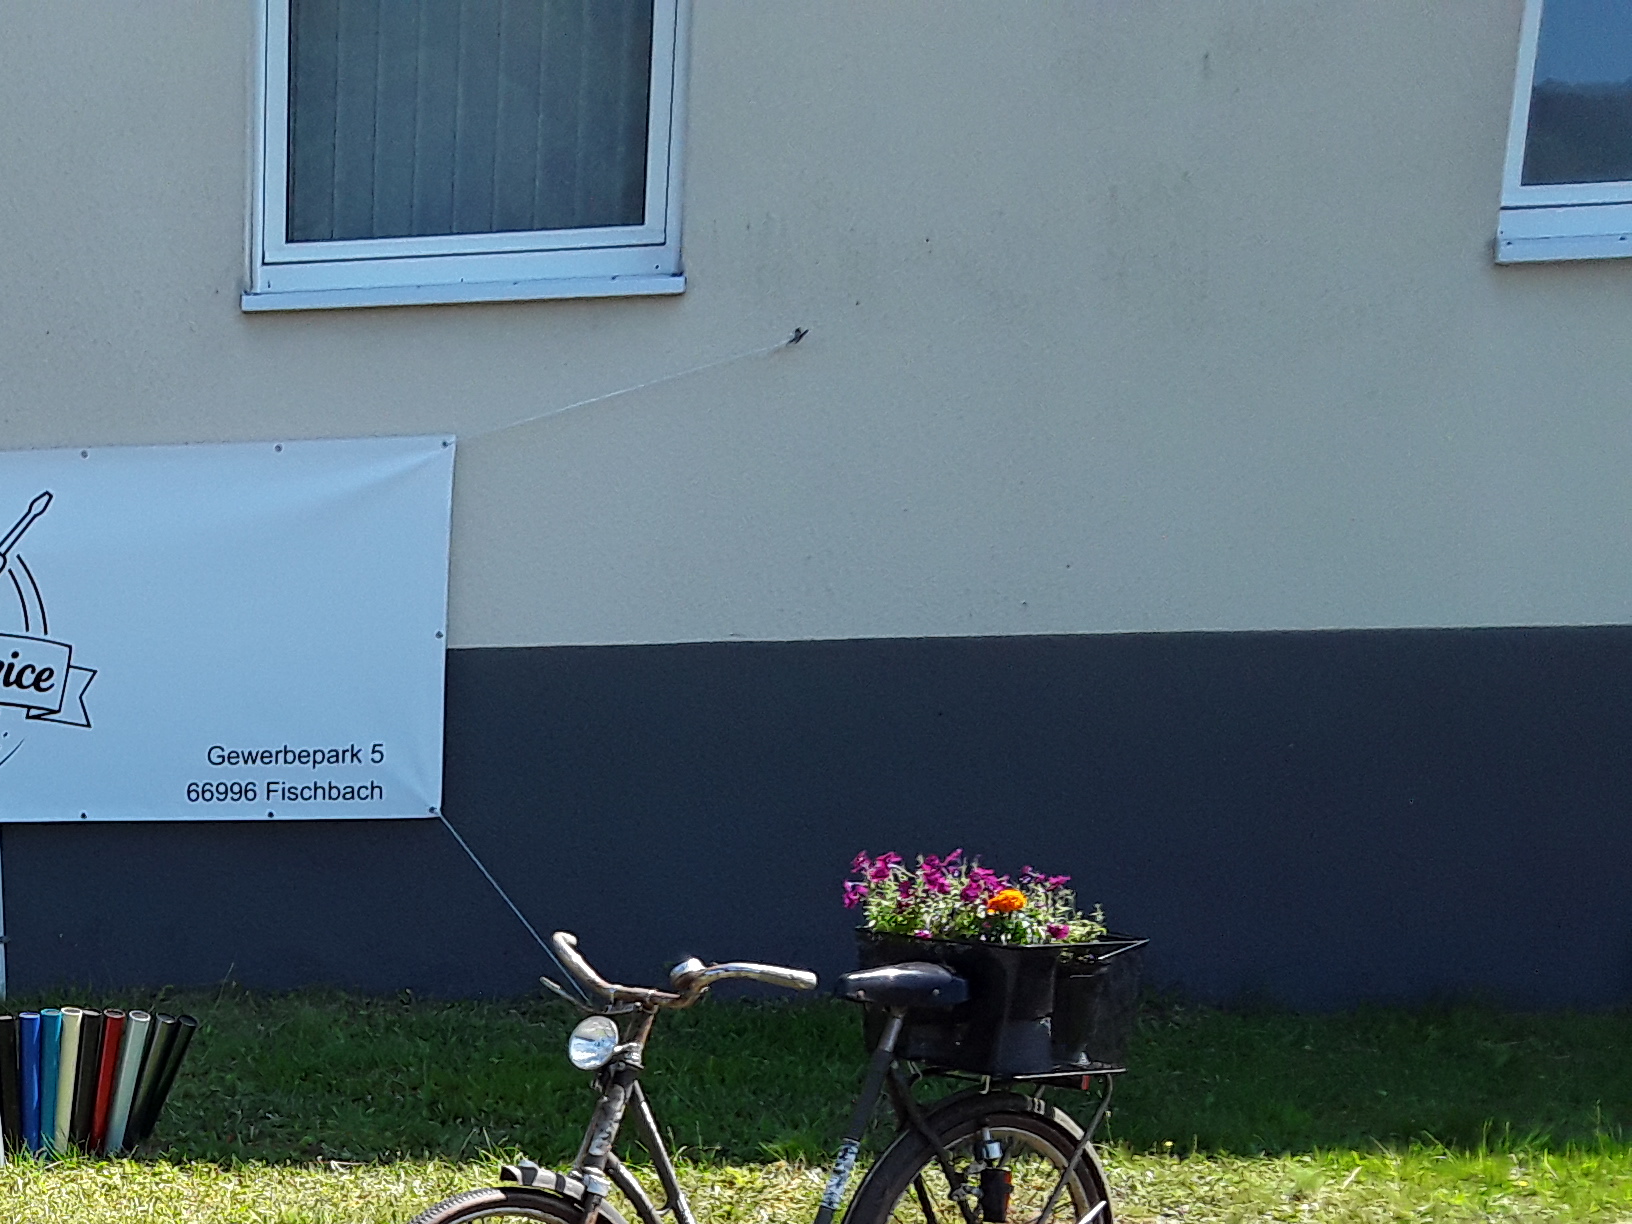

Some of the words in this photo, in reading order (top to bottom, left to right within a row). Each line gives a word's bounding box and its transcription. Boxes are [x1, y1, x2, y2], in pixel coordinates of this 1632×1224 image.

[207, 744, 363, 769] Gewerbepark
[370, 743, 385, 764] 5
[186, 781, 258, 803] 66996
[266, 780, 384, 802] Fischbach
